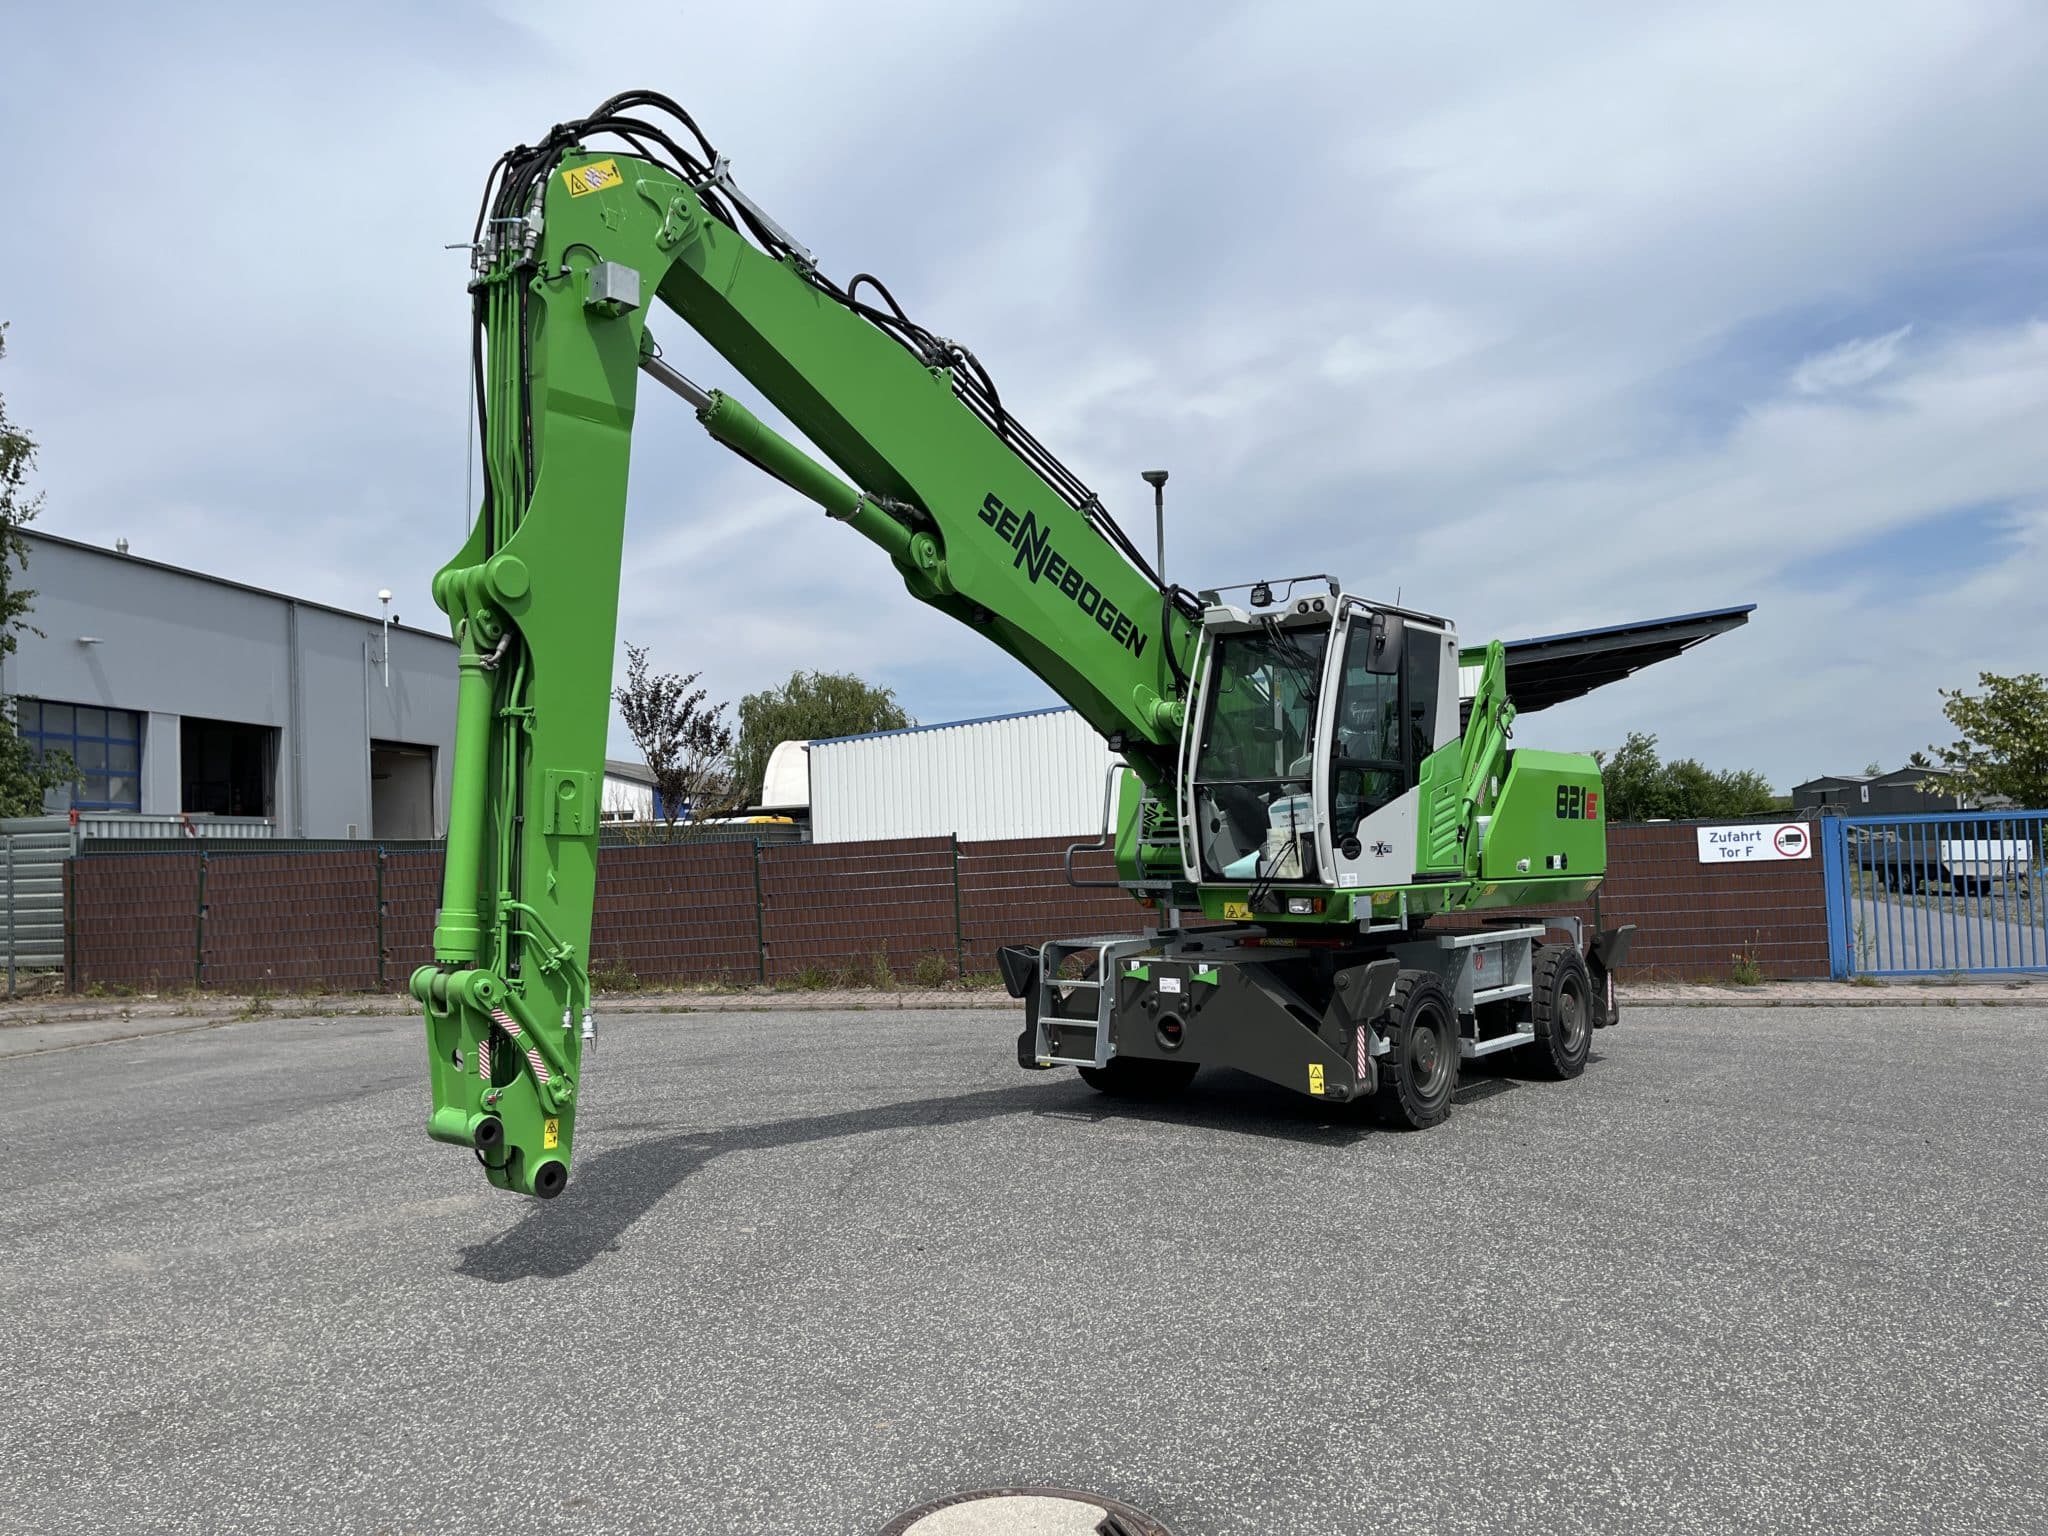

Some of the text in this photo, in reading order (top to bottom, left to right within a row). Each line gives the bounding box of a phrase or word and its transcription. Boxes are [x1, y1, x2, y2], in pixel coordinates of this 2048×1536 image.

[978, 492, 1148, 659] SENNEBOGEN
[1709, 830, 1762, 843] Zufahrt
[1719, 846, 1754, 858] Tor F
